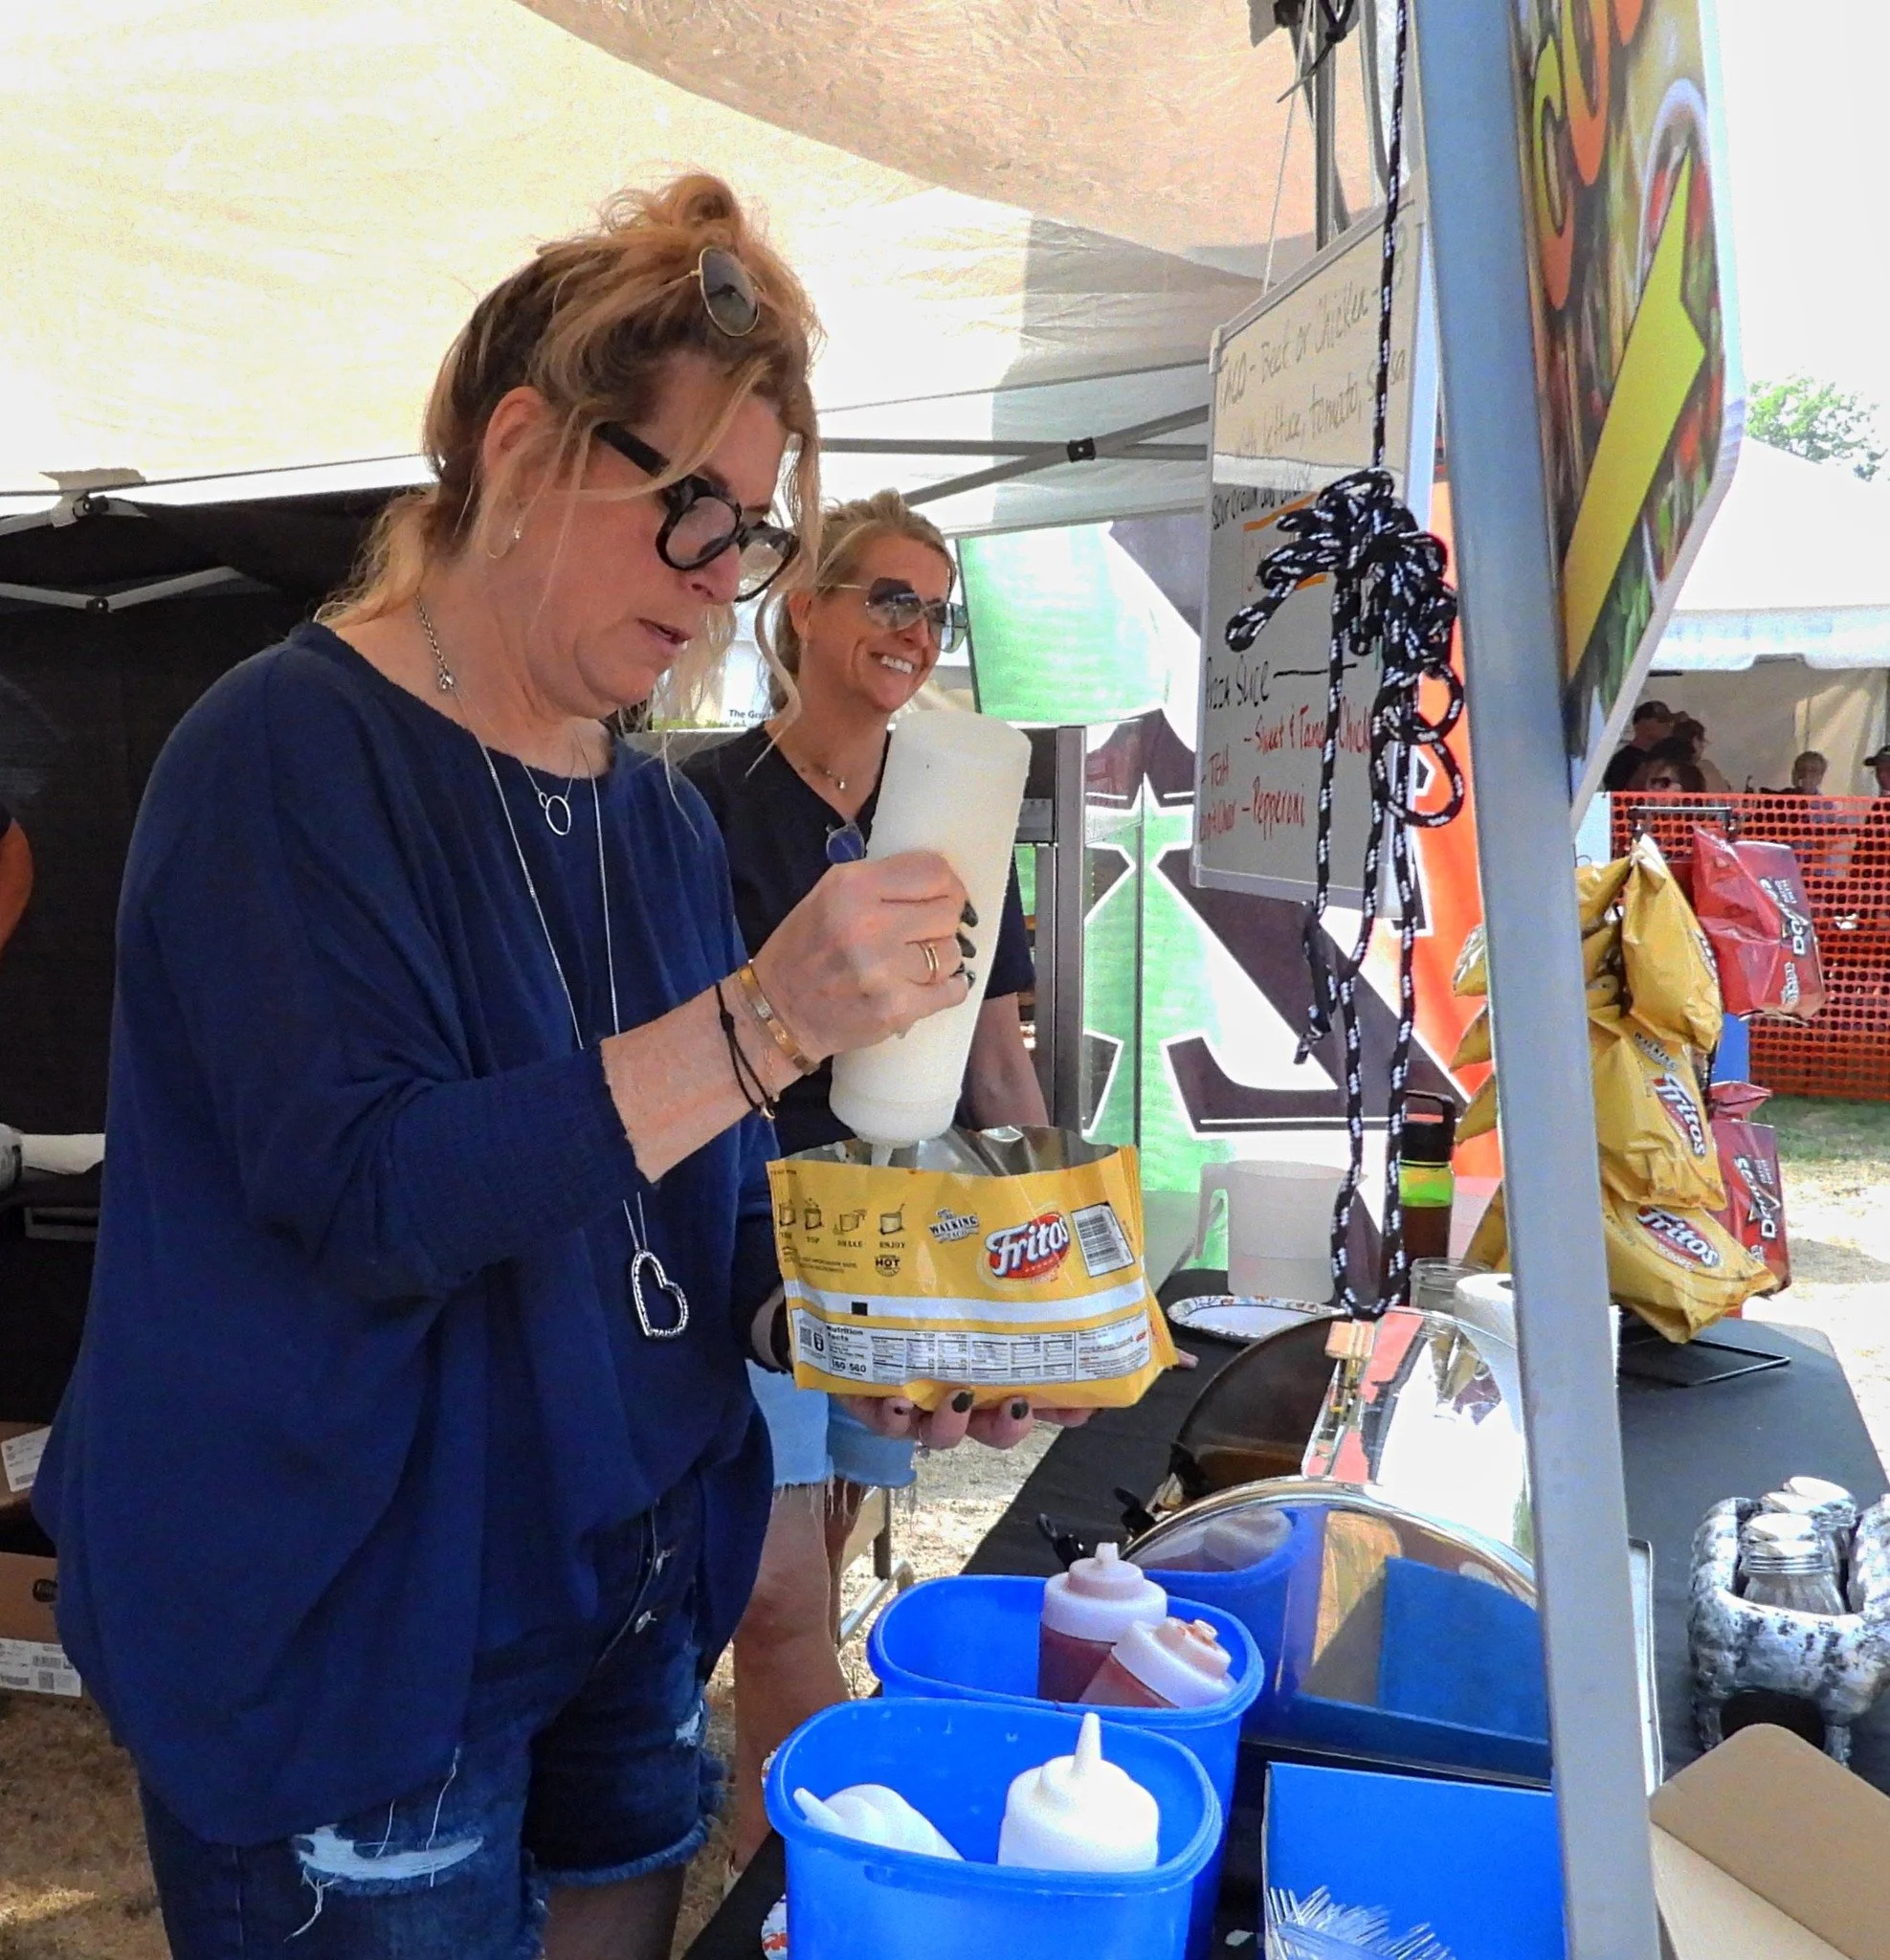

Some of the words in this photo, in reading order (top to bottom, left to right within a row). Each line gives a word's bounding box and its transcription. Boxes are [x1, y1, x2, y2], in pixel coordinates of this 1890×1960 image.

[1654, 1071, 1706, 1157] Fritos
[929, 1214, 978, 1236] WALKING
[1636, 1207, 1720, 1267] Fritos
[875, 1258, 901, 1268] HOT
[986, 1215, 1069, 1278] Fritos
[826, 1325, 864, 1336] Nutrition
